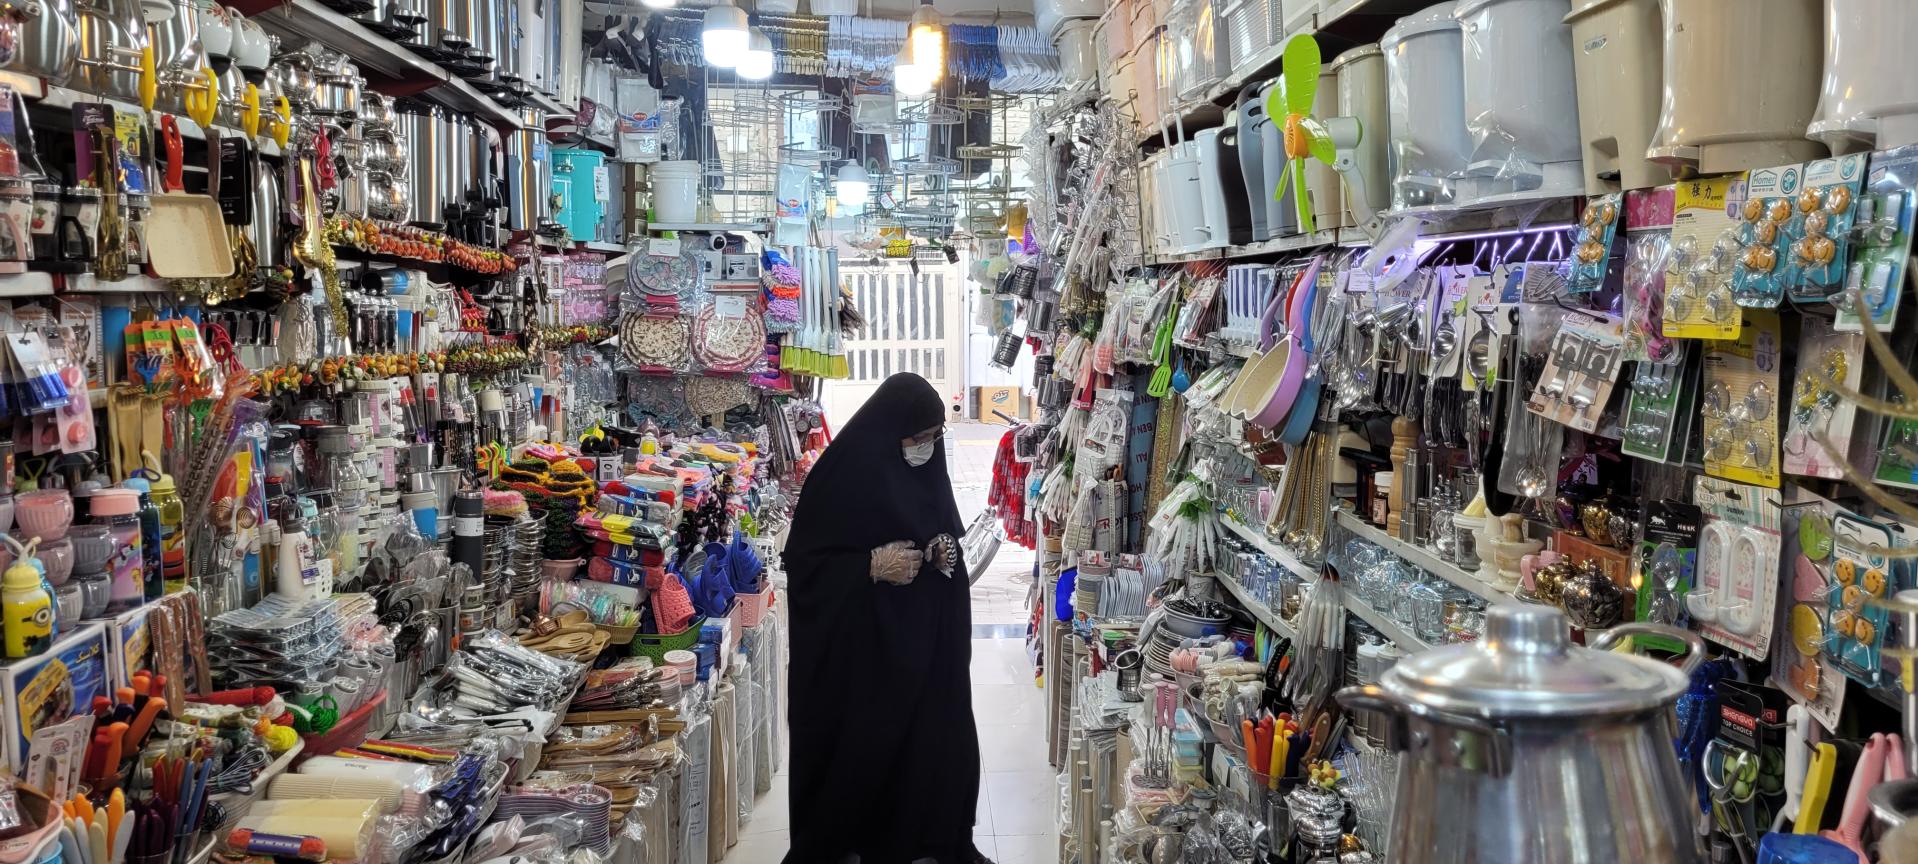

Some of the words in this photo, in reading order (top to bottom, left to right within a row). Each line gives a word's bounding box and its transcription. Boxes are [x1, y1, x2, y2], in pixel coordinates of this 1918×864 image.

[1753, 176, 1776, 185] Homer
[1722, 718, 1732, 728] TOP
[1732, 723, 1753, 737] CHOICE
